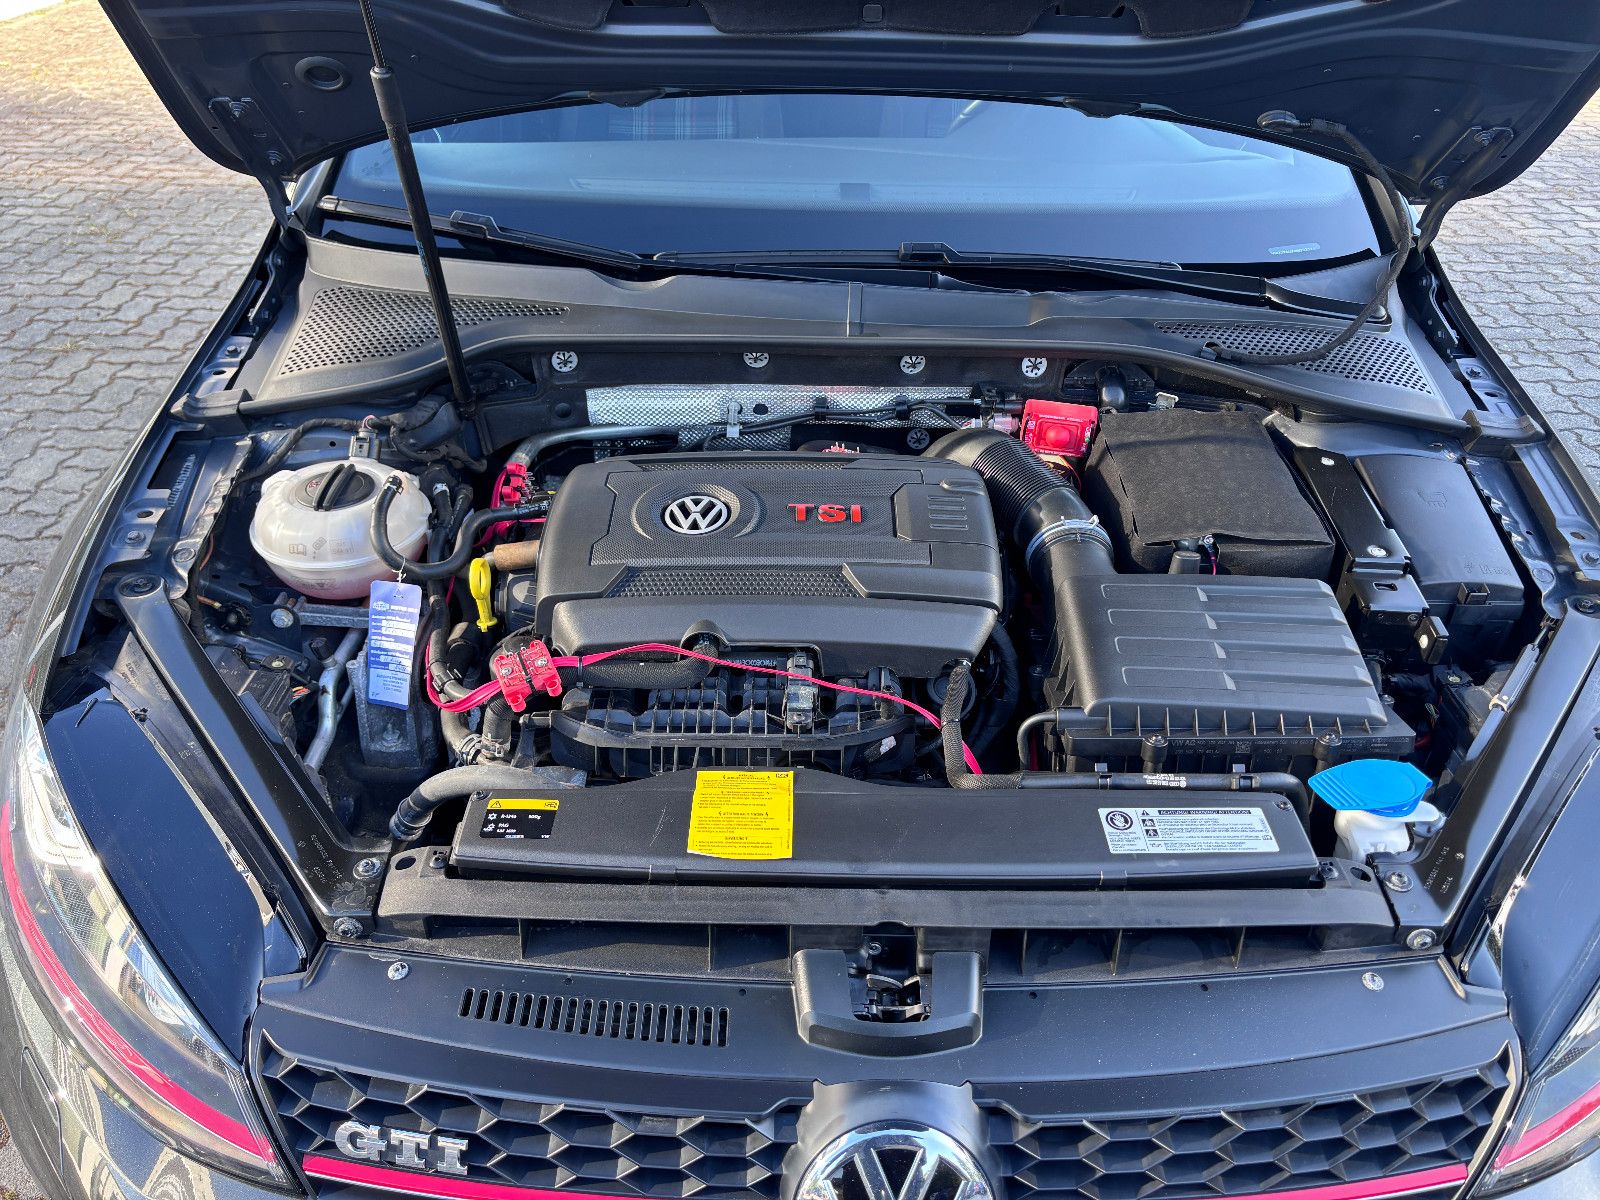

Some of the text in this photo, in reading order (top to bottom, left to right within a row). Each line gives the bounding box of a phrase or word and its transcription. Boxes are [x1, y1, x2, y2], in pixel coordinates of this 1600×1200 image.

[664, 495, 729, 534] VW
[787, 503, 862, 523] TSI
[334, 1120, 469, 1176] GTI
